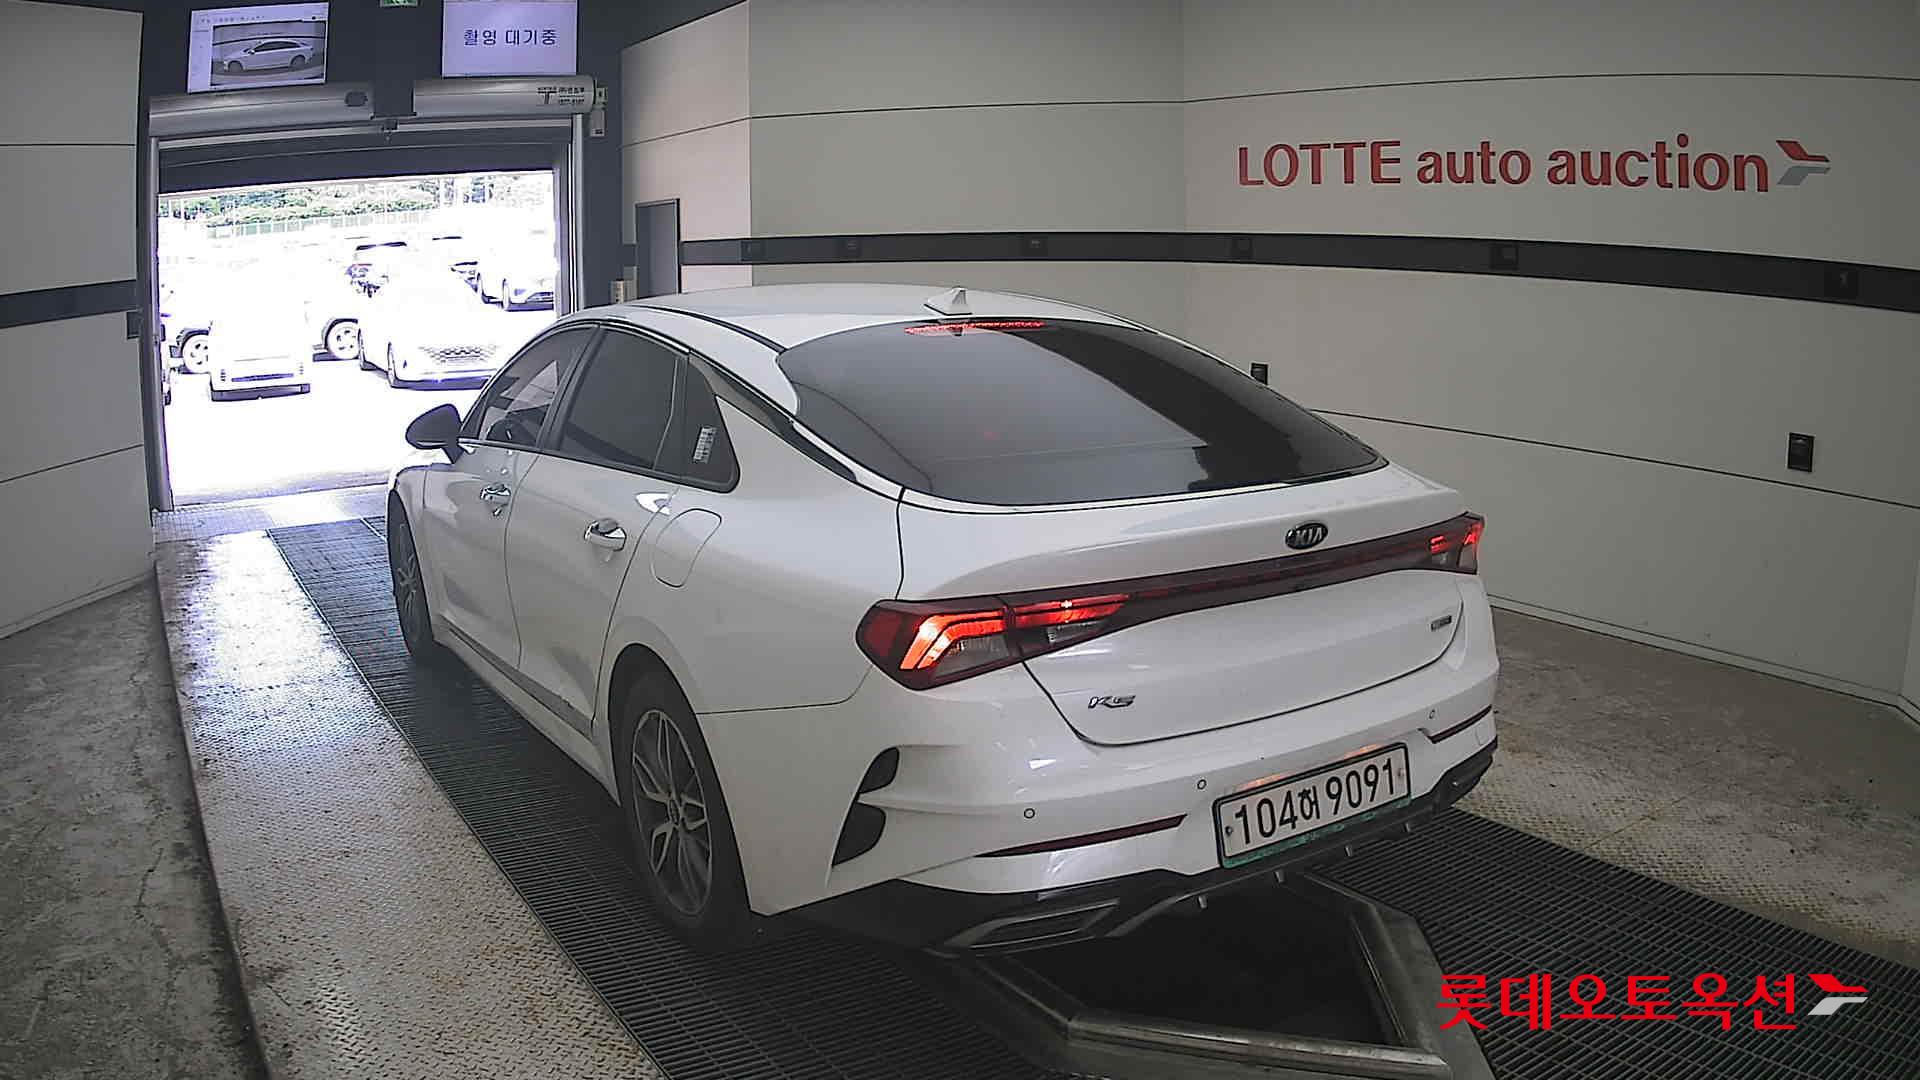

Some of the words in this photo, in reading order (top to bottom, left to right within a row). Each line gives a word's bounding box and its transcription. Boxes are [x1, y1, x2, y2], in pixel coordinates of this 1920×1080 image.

[1238, 140, 1402, 187] LOTTE
[1416, 141, 1532, 185] auto
[1547, 133, 1769, 192] auction
[1292, 526, 1324, 546] KIA
